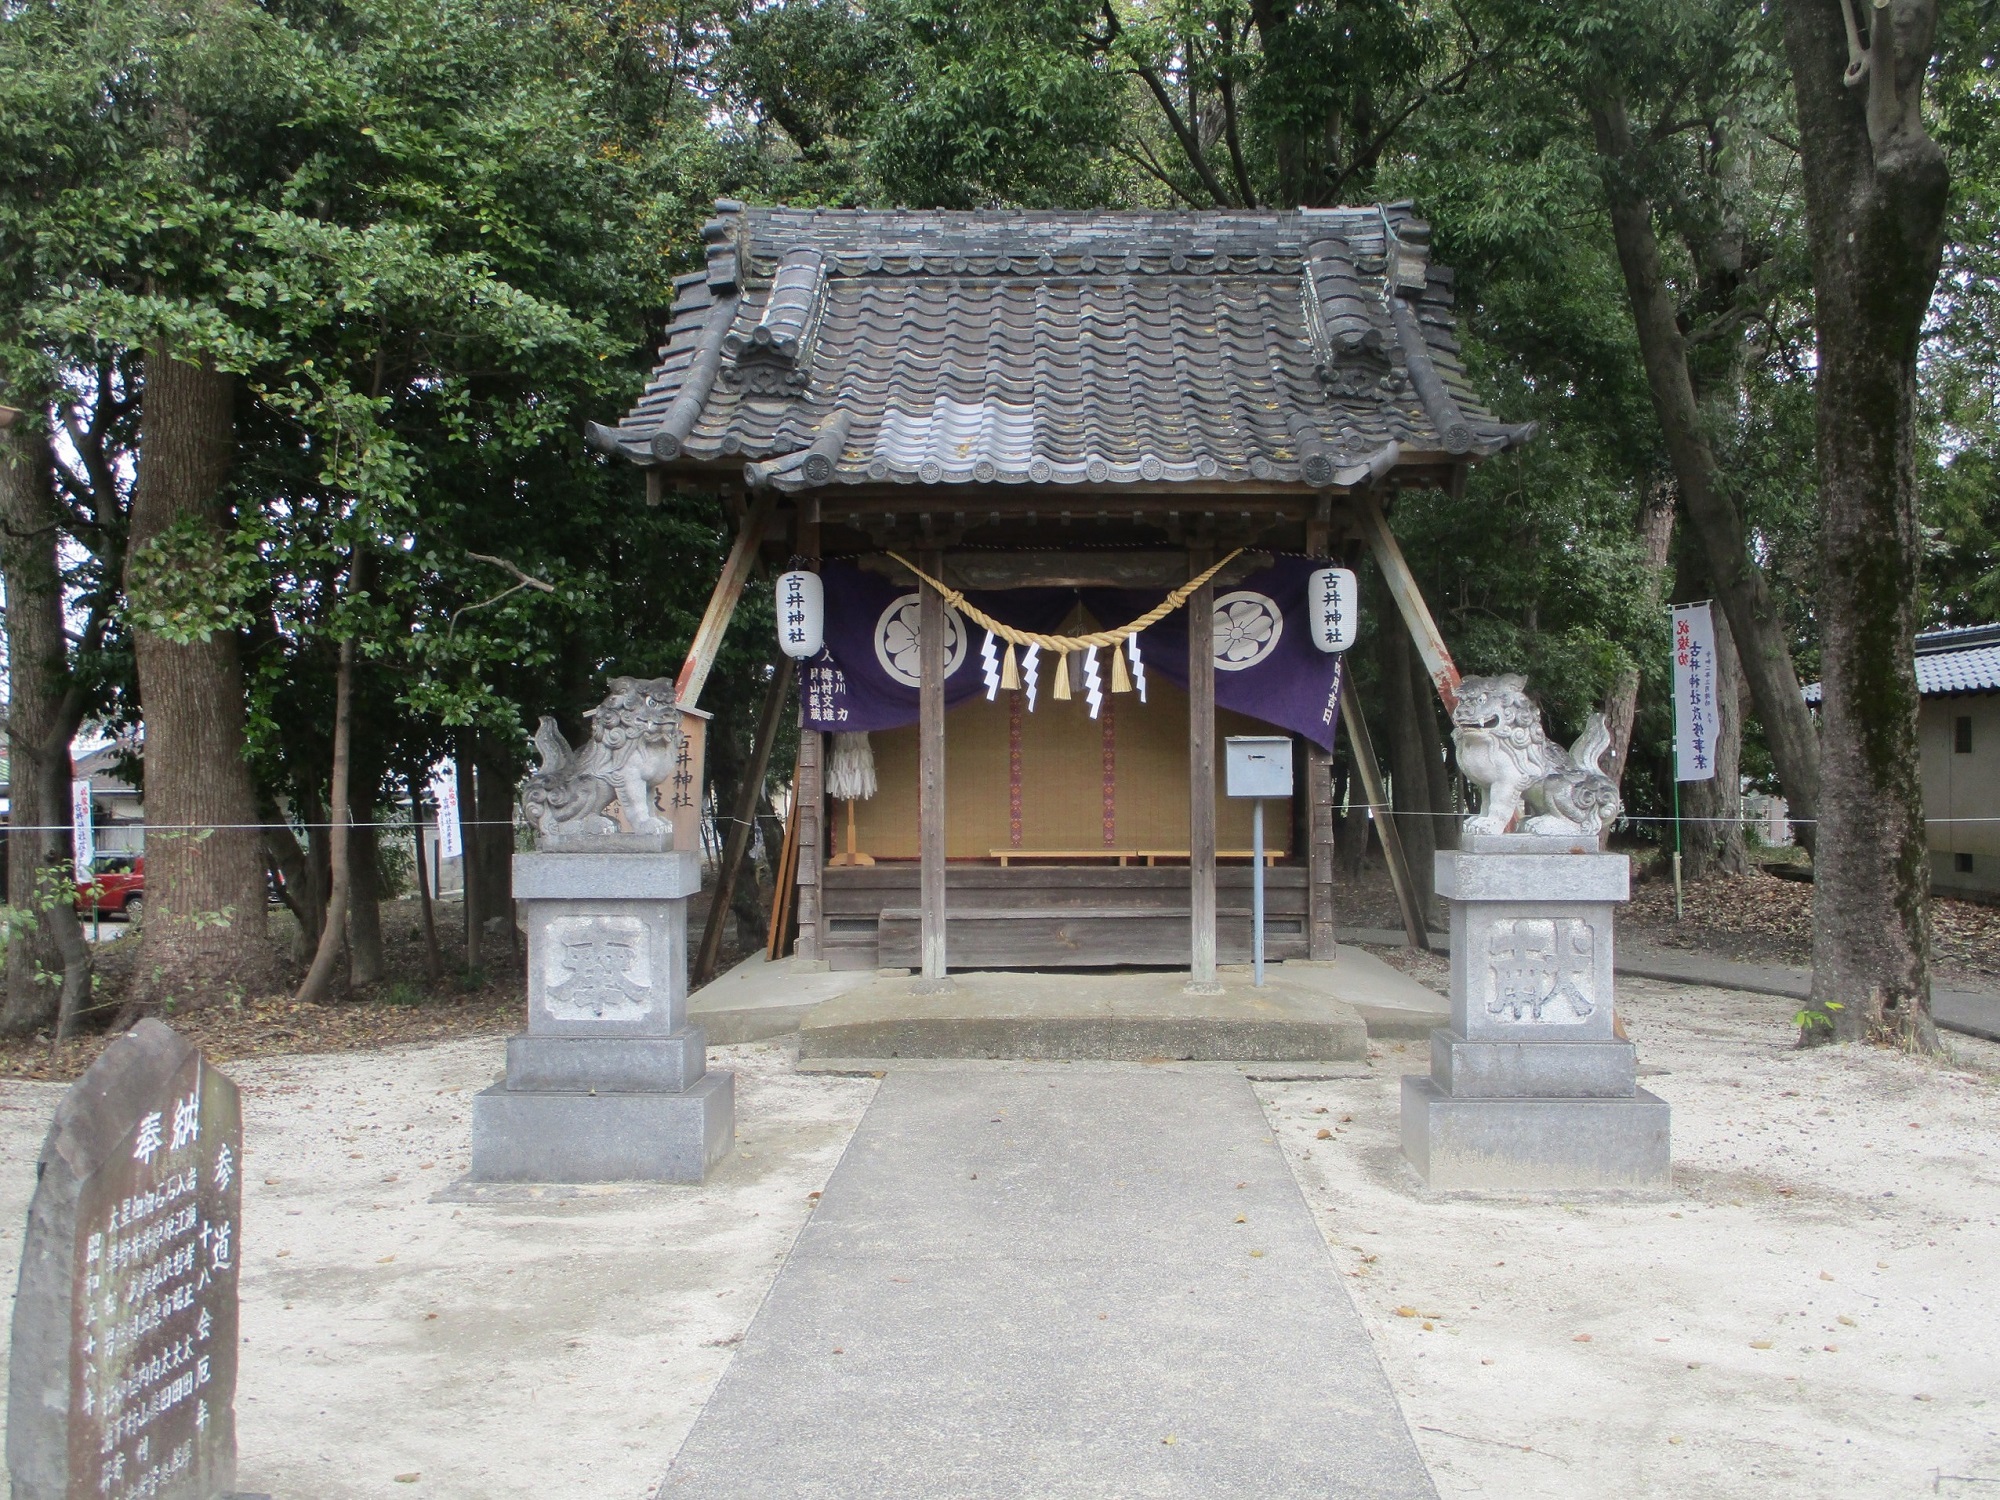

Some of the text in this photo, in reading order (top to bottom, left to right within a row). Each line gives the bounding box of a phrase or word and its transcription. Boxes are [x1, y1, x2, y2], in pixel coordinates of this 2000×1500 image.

[786, 575, 806, 644] 古井神社
[1322, 572, 1343, 644] 古井神社
[133, 1092, 199, 1165] 奉納
